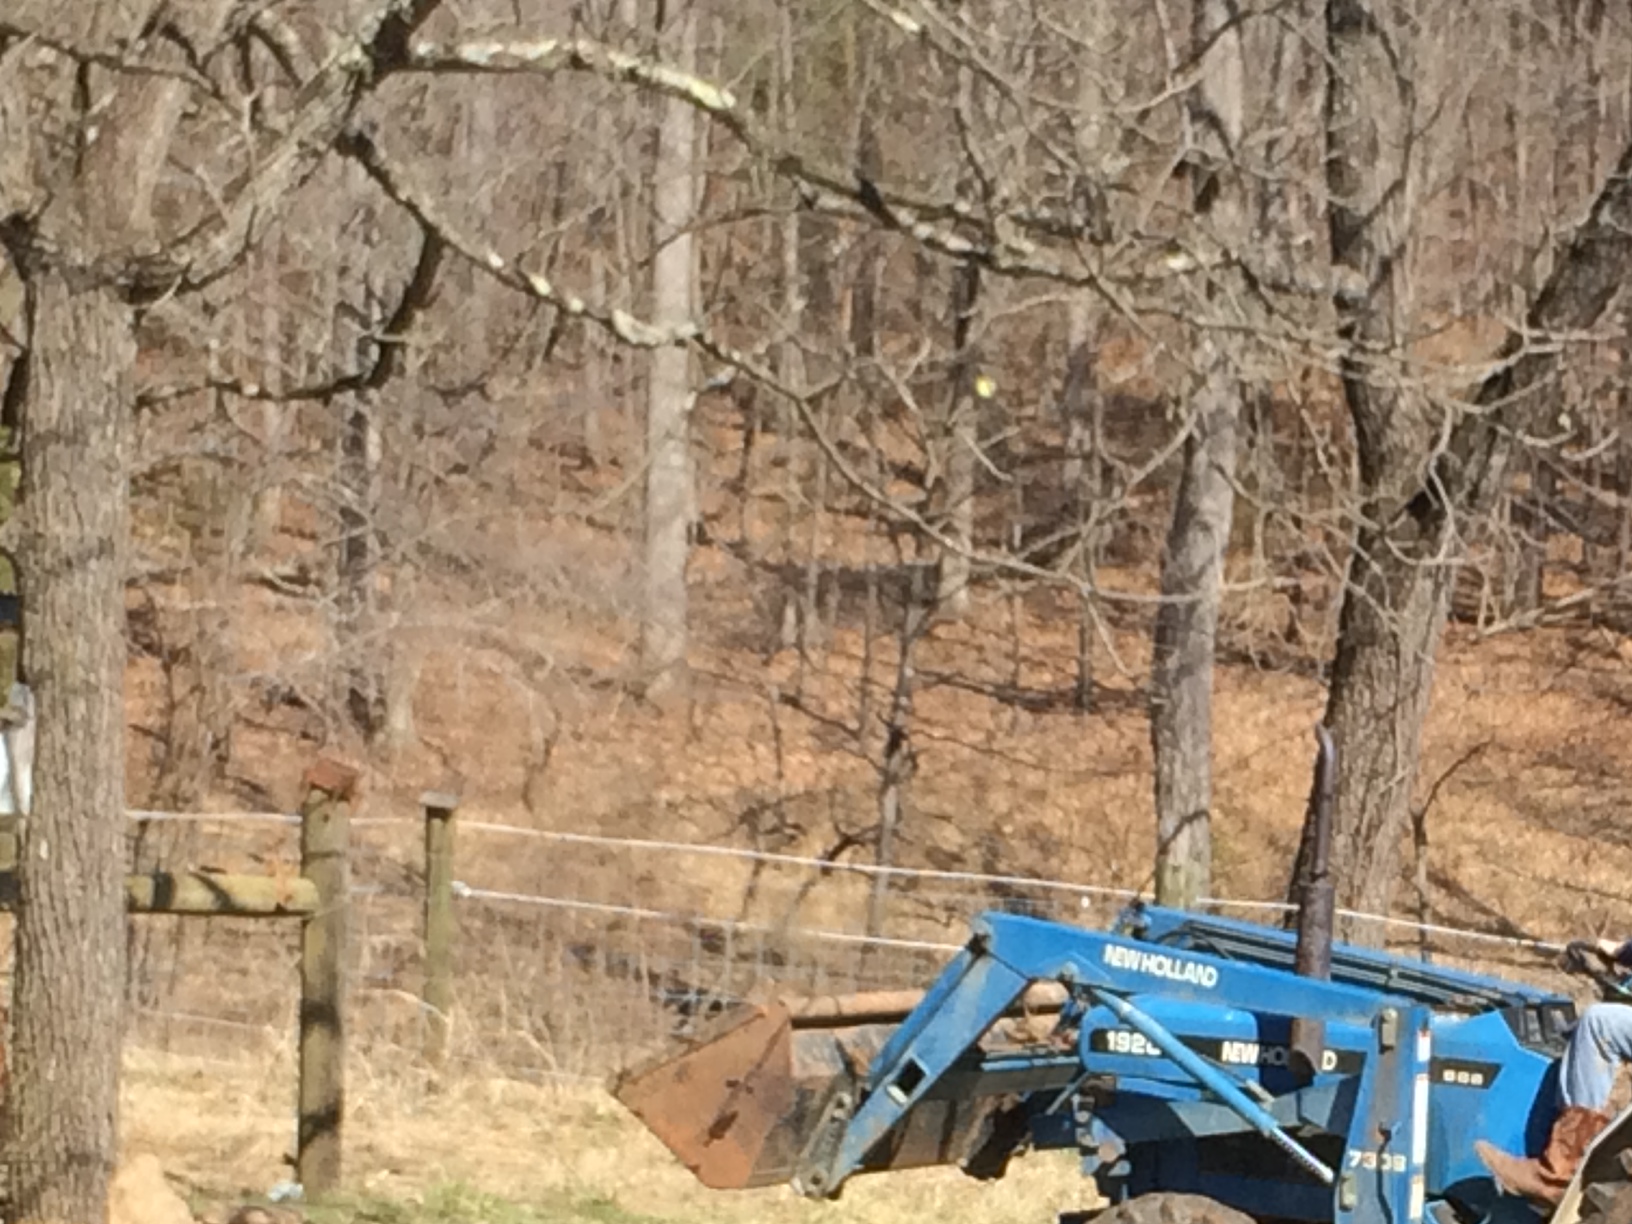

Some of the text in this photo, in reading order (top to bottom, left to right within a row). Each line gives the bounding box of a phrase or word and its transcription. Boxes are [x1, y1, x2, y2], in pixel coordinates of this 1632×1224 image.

[1103, 943, 1219, 989] NEW HOLLAND
[1220, 1040, 1259, 1065] NEW
